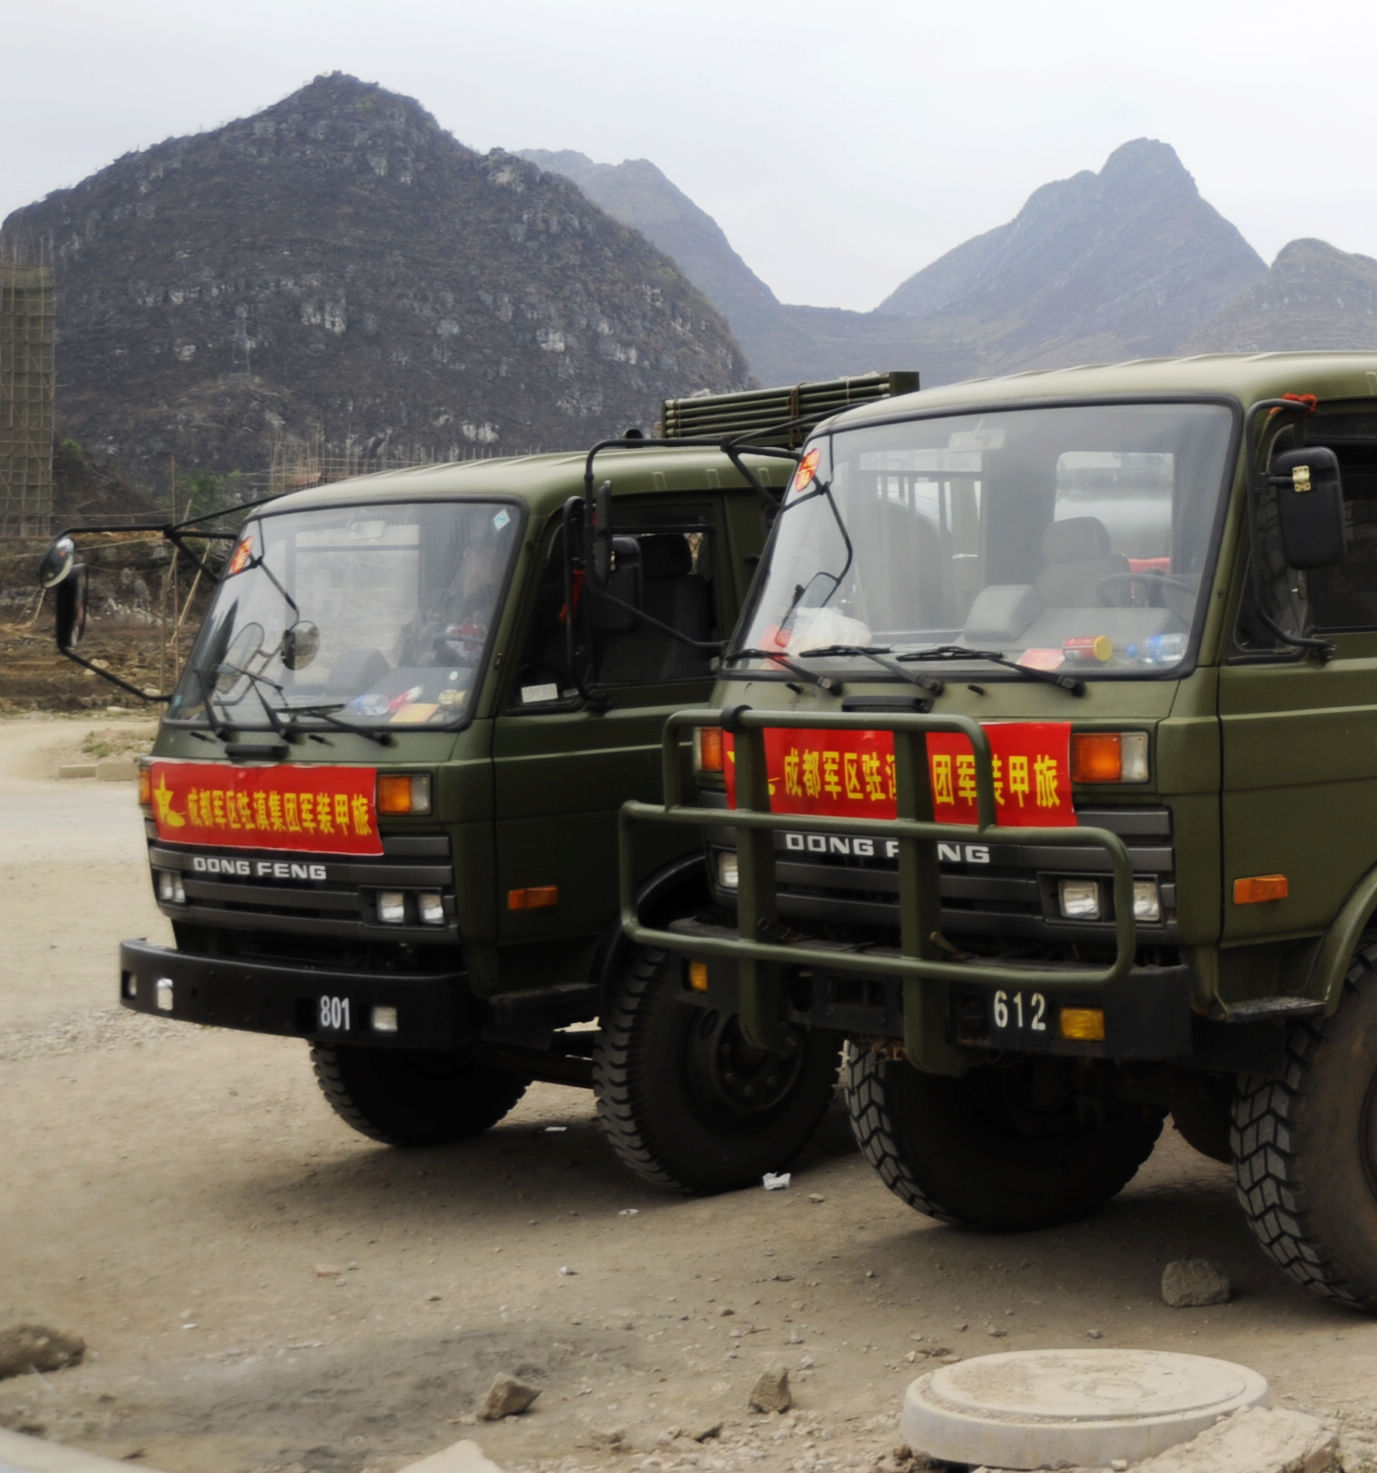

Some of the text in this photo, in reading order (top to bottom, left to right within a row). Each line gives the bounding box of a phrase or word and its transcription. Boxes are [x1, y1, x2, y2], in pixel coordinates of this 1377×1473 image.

[785, 833, 990, 863] DONG FNG
[192, 857, 327, 880] DONG FENG
[320, 994, 350, 1030] 801
[994, 989, 1046, 1031] 612
